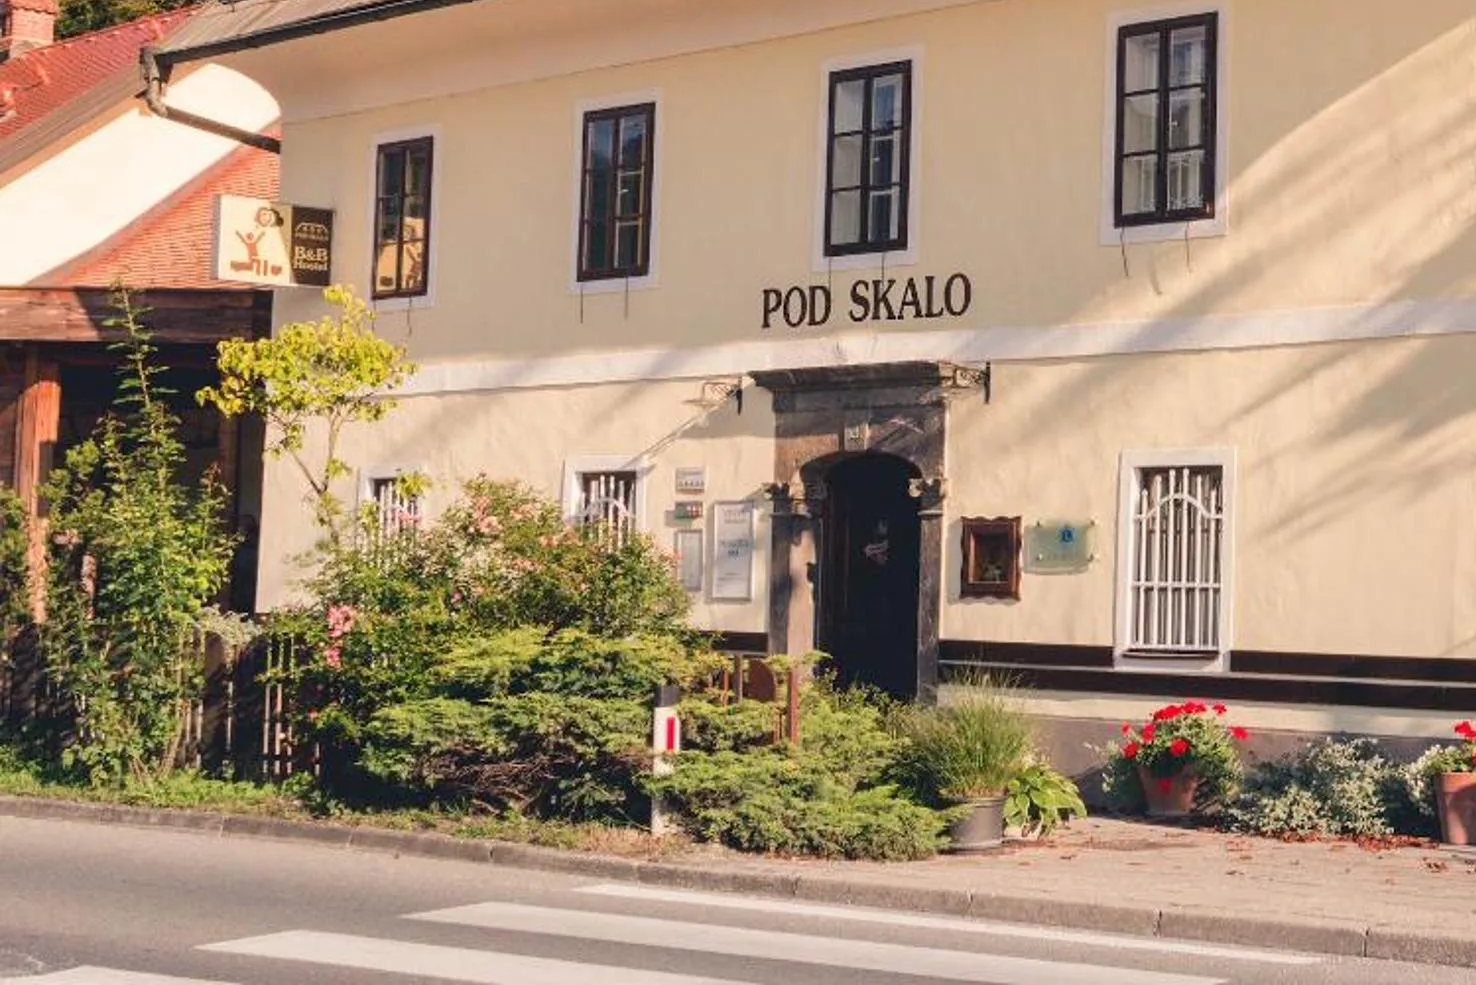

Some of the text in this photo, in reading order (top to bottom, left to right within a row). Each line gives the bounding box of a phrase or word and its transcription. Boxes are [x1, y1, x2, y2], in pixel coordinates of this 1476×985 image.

[294, 246, 328, 262] B&B
[761, 272, 972, 328] POD SKALO
